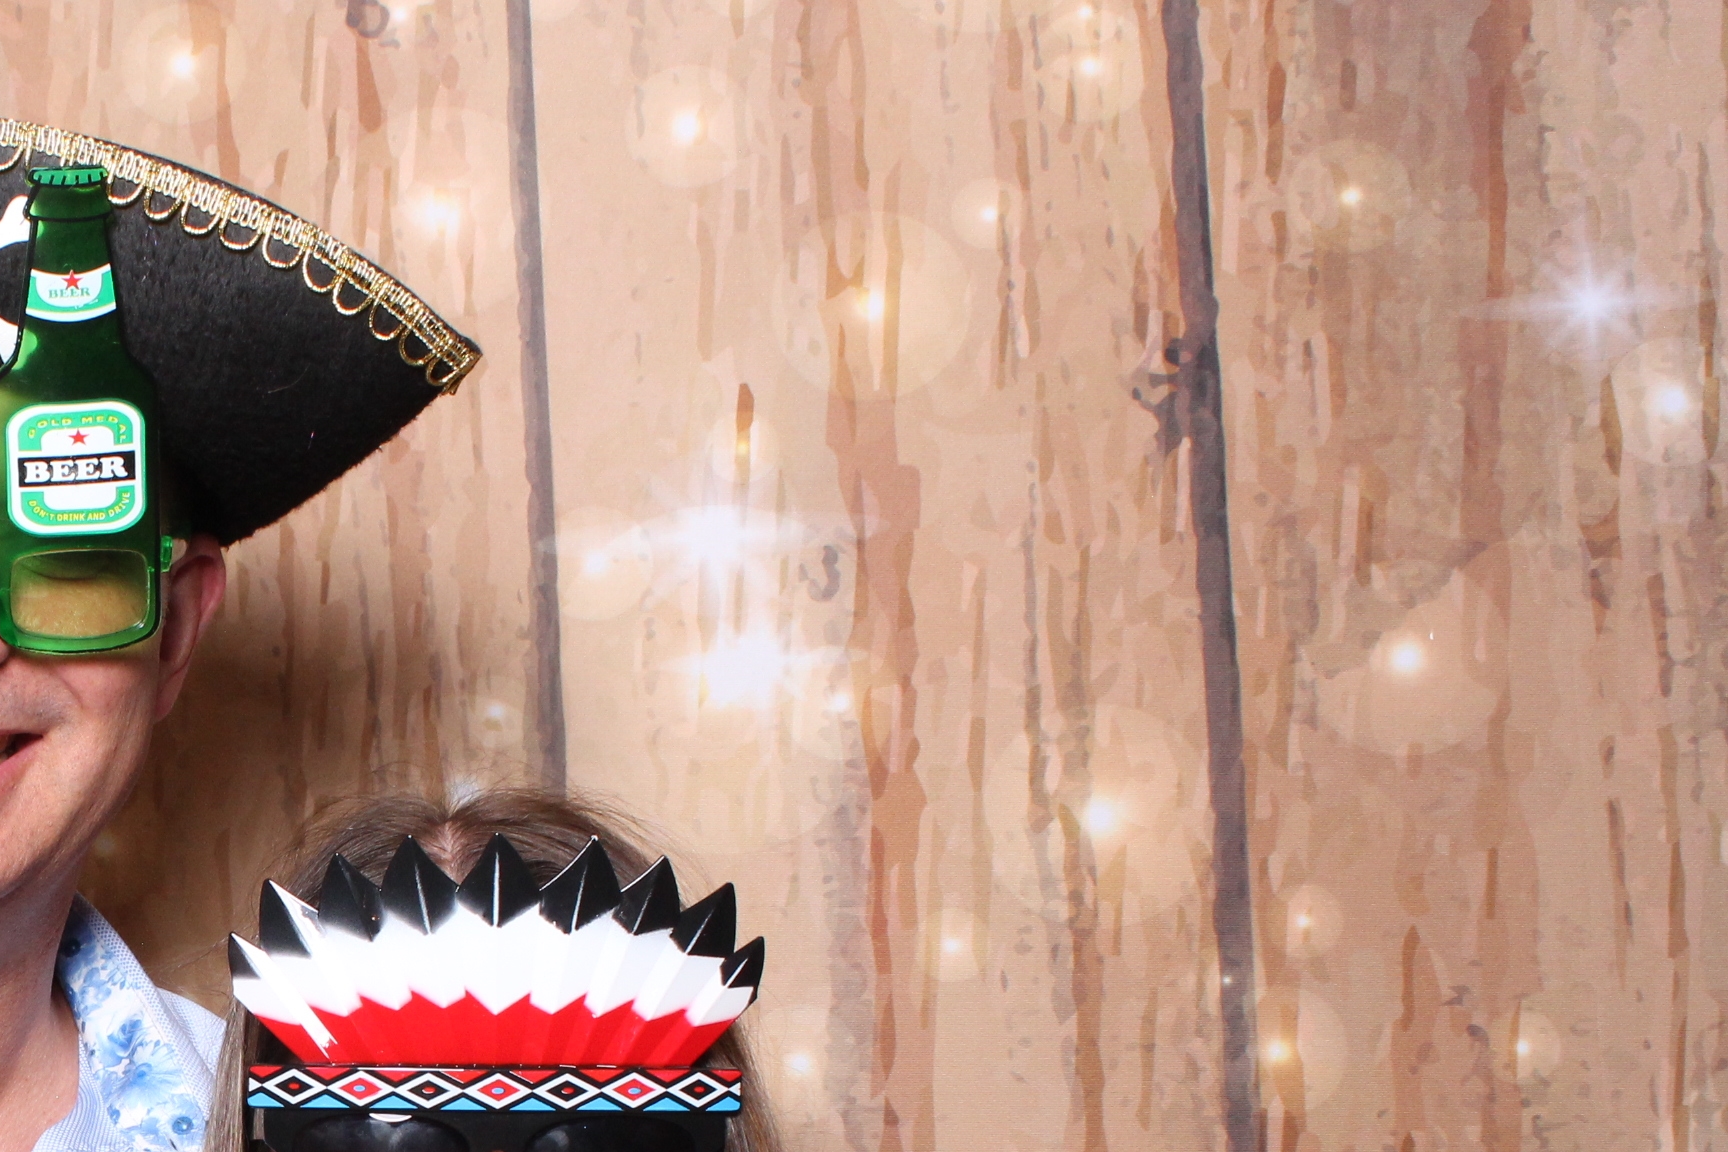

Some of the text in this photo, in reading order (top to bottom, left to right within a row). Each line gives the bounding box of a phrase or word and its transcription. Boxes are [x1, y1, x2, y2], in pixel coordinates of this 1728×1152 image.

[48, 287, 91, 299] BEER
[24, 456, 128, 483] BEER
[28, 491, 131, 521] DON'T DRINK AND DRIVE
